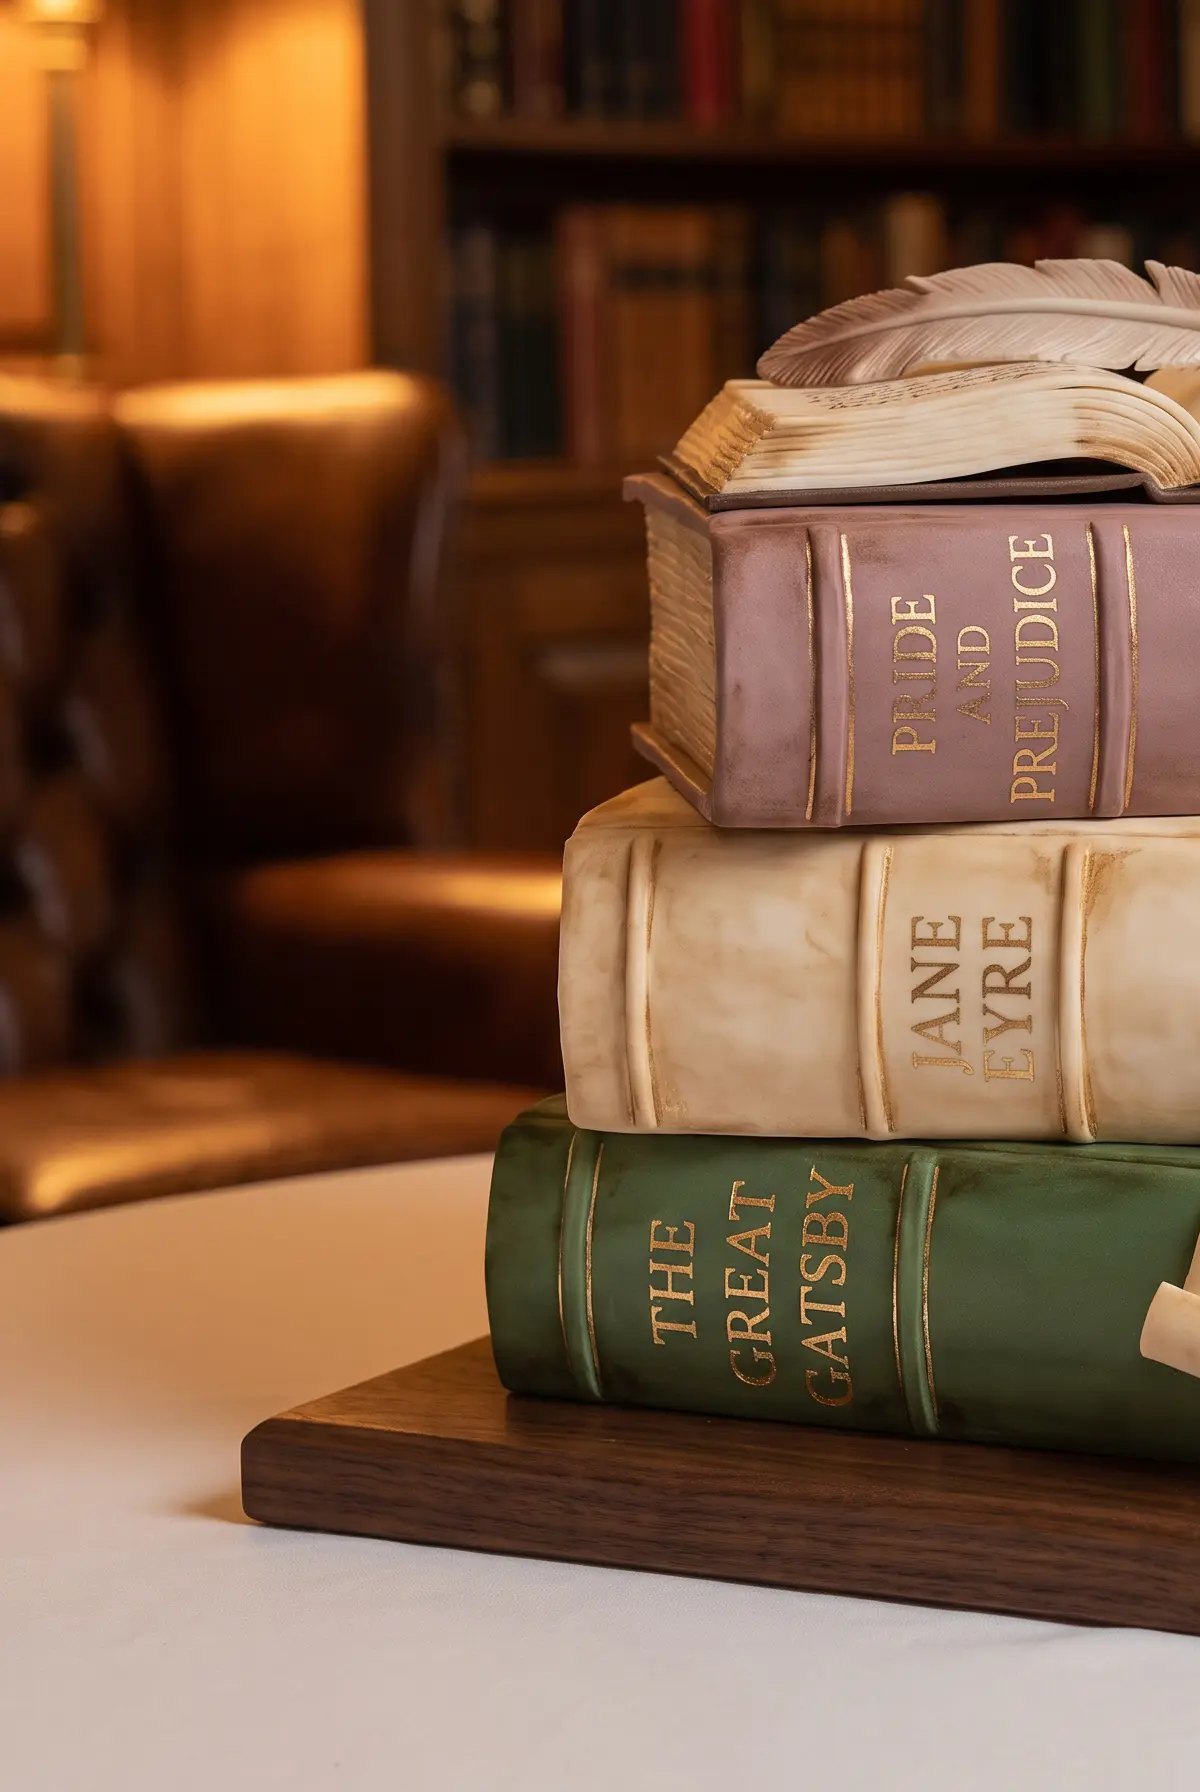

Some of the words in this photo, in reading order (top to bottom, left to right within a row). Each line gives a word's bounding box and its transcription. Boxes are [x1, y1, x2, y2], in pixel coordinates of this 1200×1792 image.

[890, 593, 937, 756] PRIDE
[956, 625, 991, 725] AND
[1008, 533, 1069, 804] PREJUDICE
[911, 915, 974, 1076] JANE
[982, 916, 1035, 1082] EYRE
[649, 1219, 698, 1345] THE
[724, 1180, 777, 1387] GREAT
[799, 1165, 854, 1408] GATSBY
